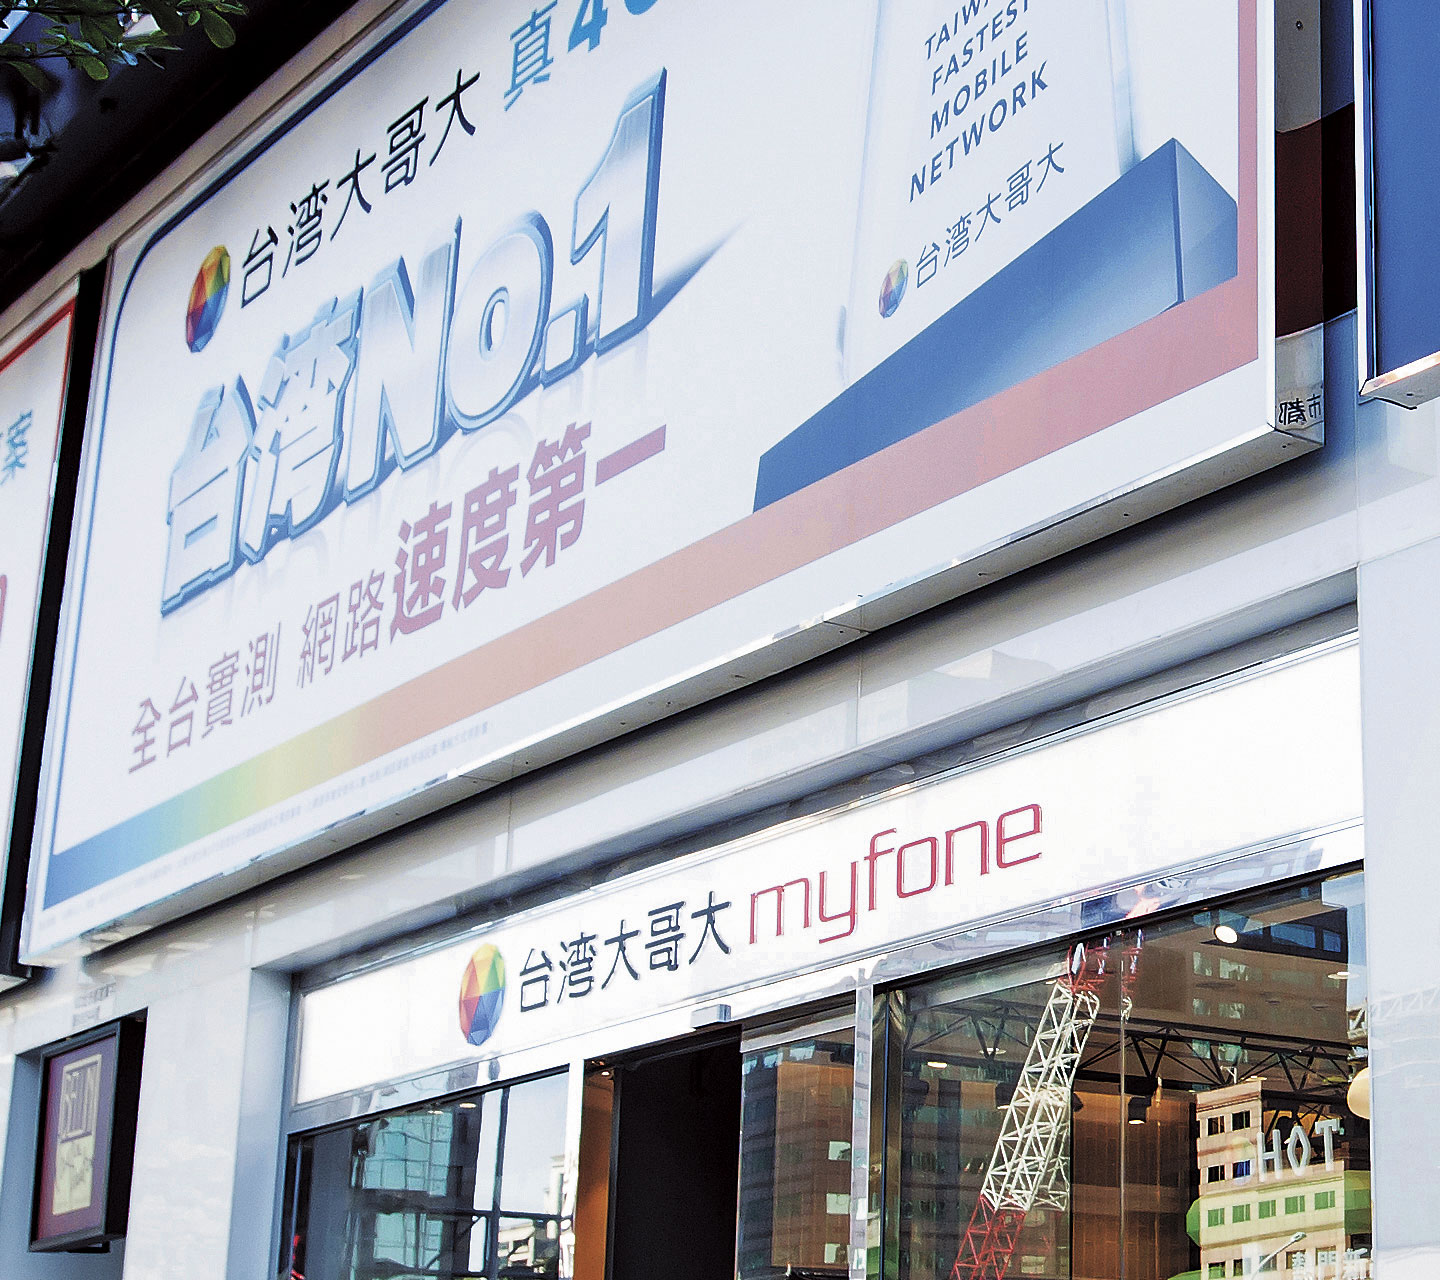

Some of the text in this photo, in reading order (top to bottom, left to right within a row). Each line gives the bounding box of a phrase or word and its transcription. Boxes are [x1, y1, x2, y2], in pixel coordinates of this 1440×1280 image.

[908, 60, 1051, 204] NETWORK
[928, 30, 1031, 140] MOBILE
[128, 423, 669, 776] 全台實測 網路速度第一
[747, 803, 1044, 945] myfone
[1256, 1118, 1343, 1183] HOT
